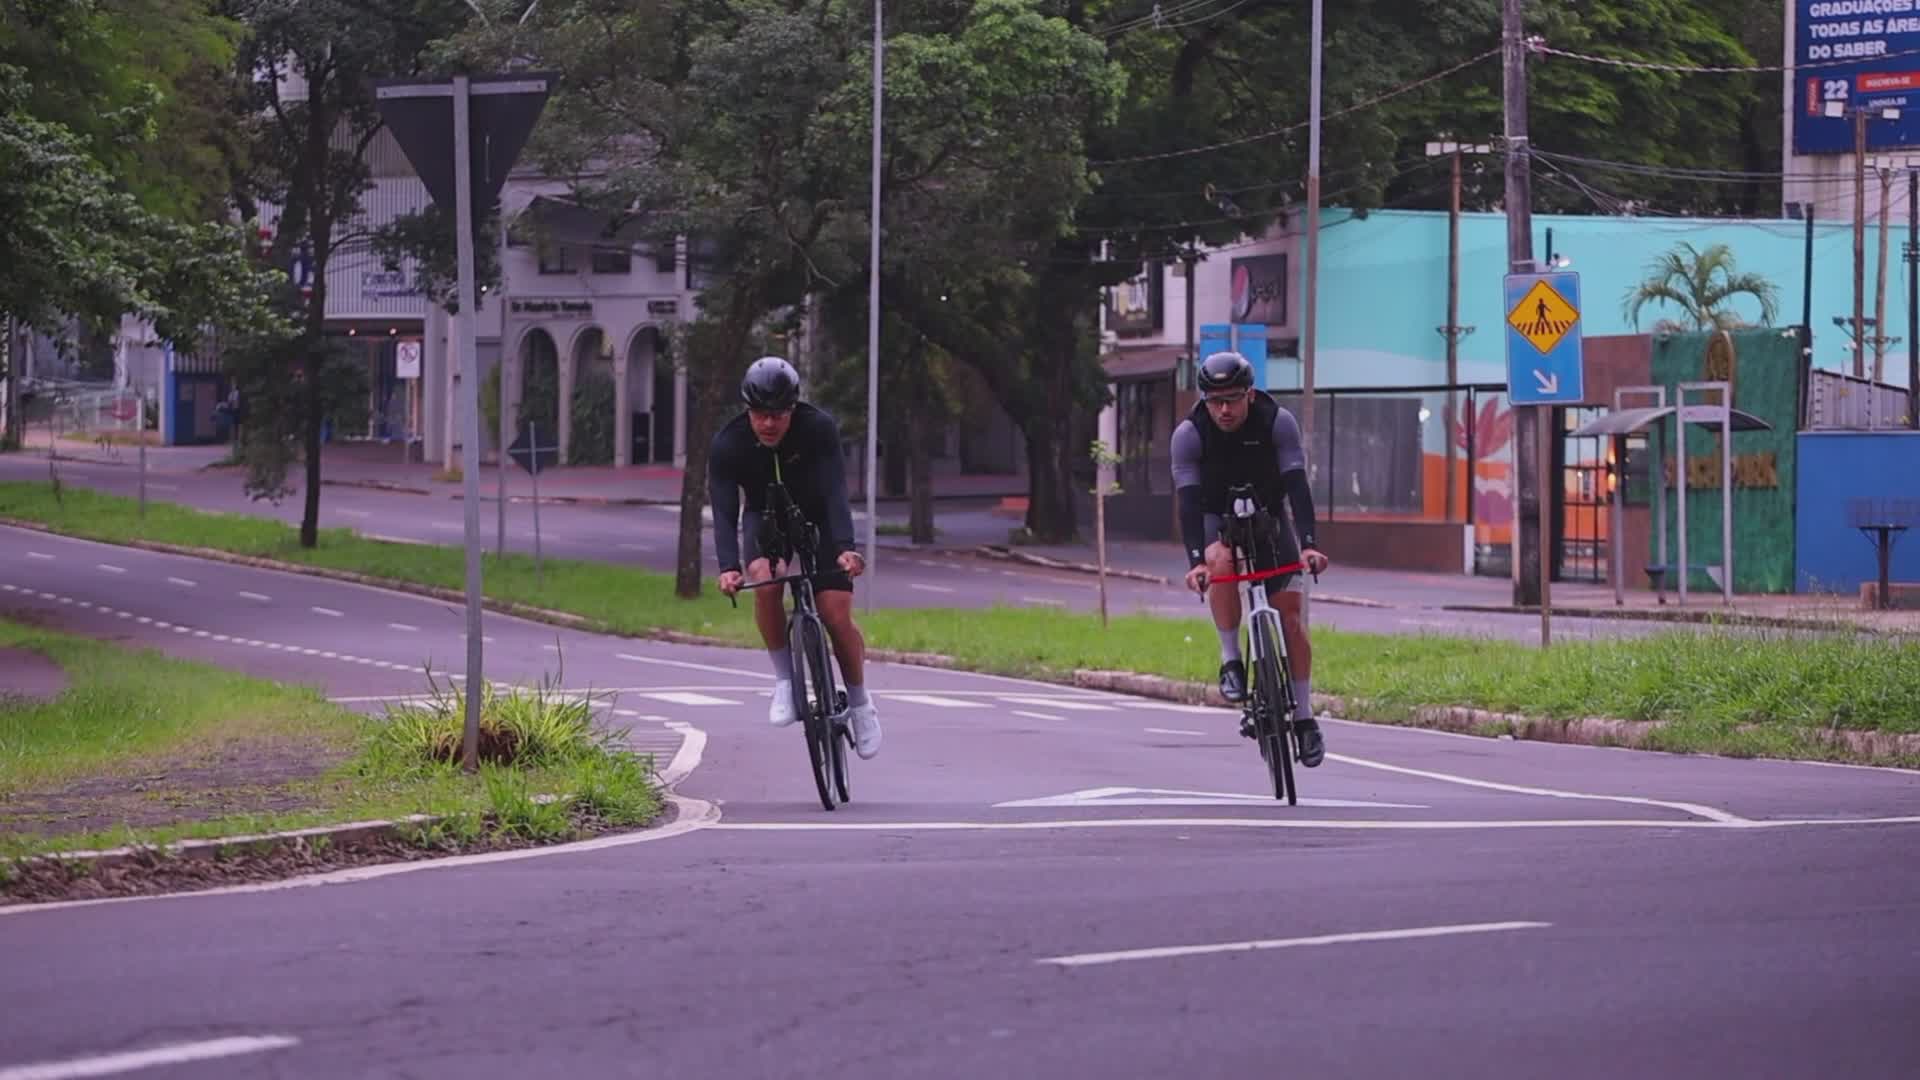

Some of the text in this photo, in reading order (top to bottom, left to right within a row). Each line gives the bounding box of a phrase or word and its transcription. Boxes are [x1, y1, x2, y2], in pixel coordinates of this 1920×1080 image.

[1809, 17, 1920, 38] TODAS AS ÁRE
[1808, 40, 1887, 59] DO SABER
[1824, 80, 1848, 100] 22
